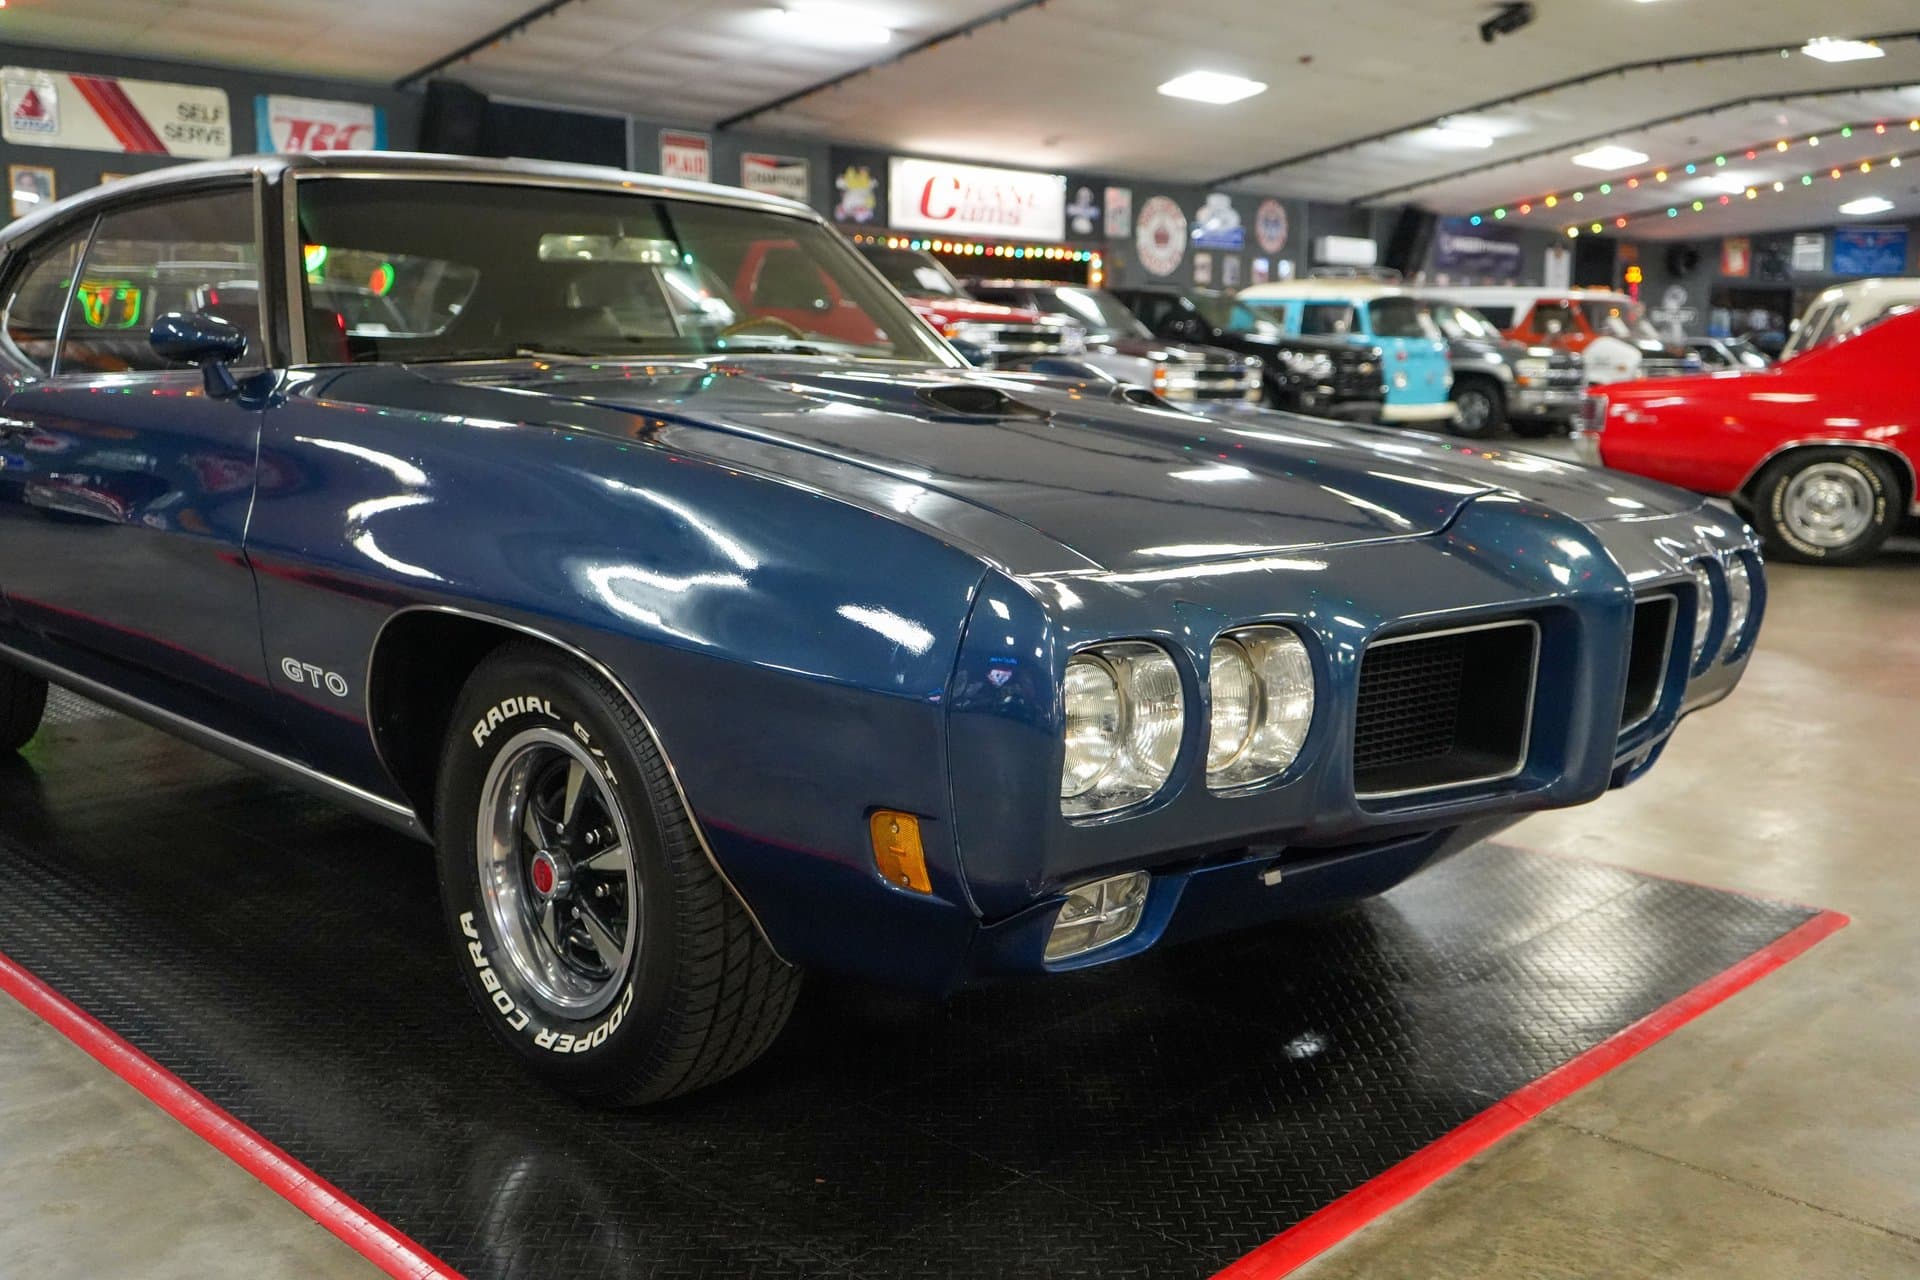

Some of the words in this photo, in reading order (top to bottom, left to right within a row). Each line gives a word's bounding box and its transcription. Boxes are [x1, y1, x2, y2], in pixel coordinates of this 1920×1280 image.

[163, 122, 225, 146] SERVE
[176, 102, 224, 123] SELF
[281, 657, 348, 697] GTO
[472, 696, 560, 748] RADIAL
[459, 911, 530, 1031] COBRA
[534, 982, 634, 1053] COOPER
